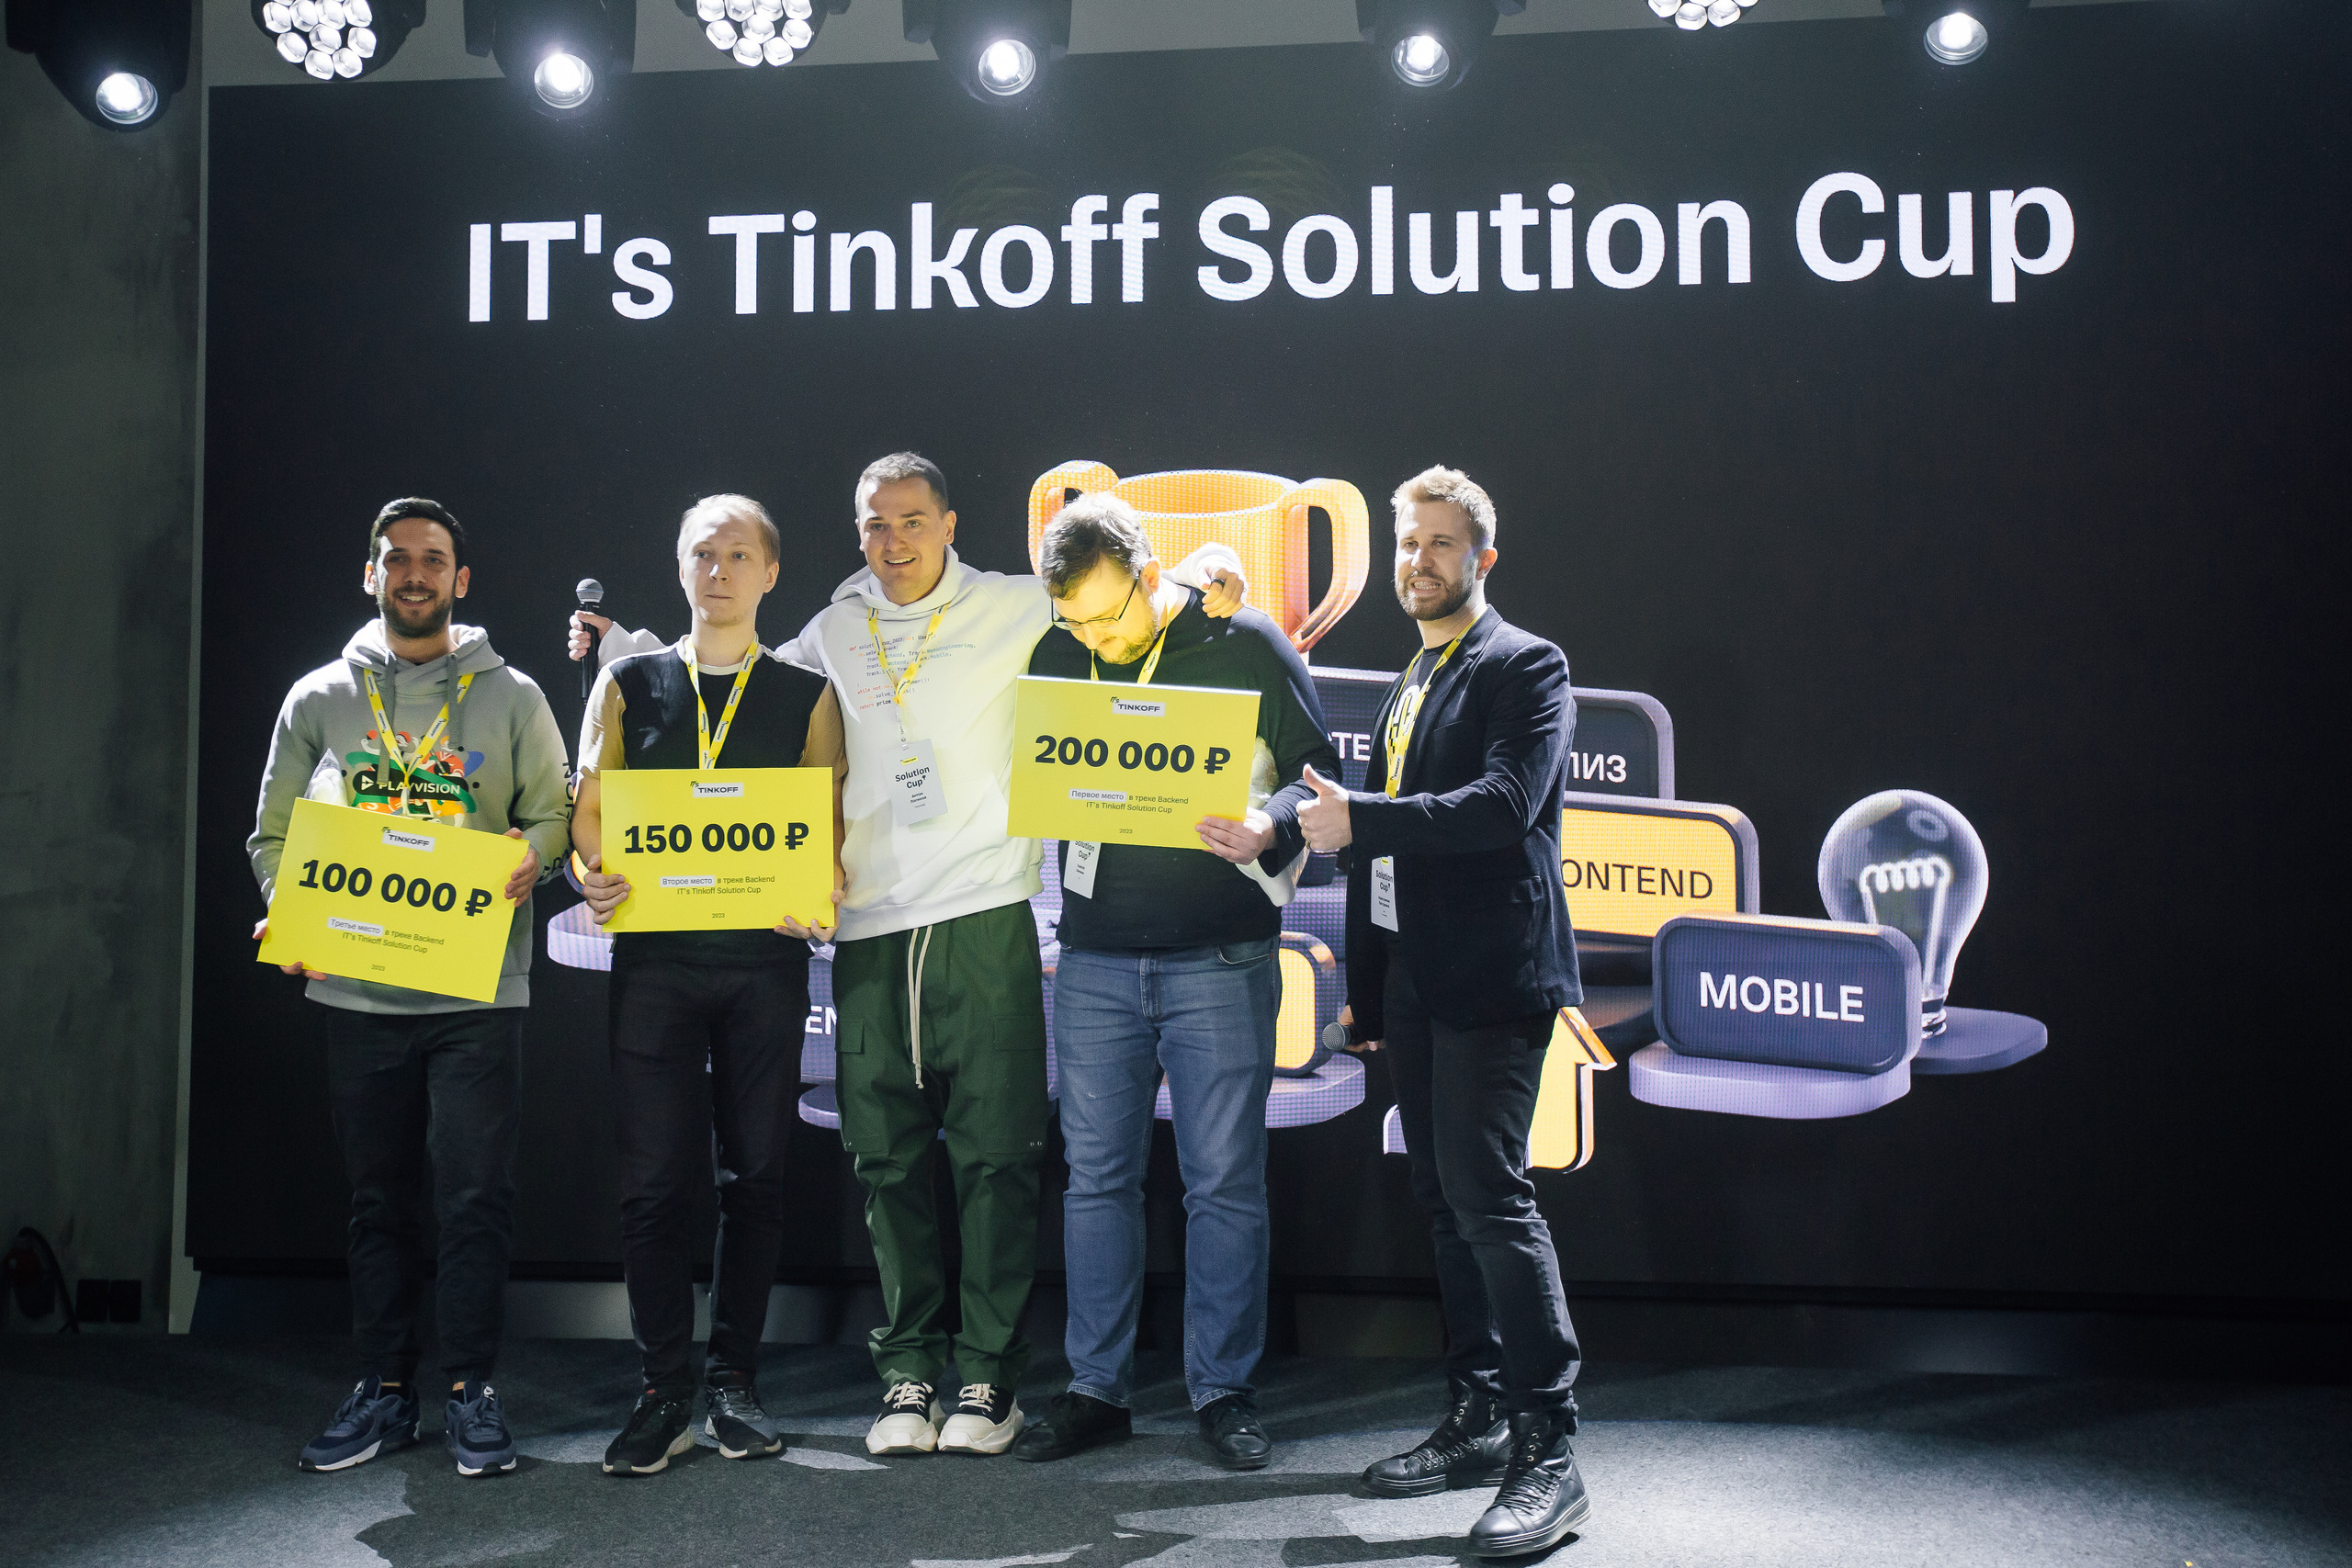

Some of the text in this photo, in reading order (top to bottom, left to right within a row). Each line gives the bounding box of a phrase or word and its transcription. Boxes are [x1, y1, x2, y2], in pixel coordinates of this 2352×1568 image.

[469, 171, 2075, 322] IT's Tinkoff Solution Cup
[1118, 704, 1160, 712] TINKOFF
[1035, 735, 1109, 768] 200
[1118, 740, 1195, 773] 000
[895, 766, 930, 783] Solution
[697, 786, 739, 795] TINKOFF
[906, 779, 923, 789] Cup
[1071, 790, 1100, 800] Первое
[1135, 795, 1157, 804] треке
[1158, 795, 1189, 805] Backend
[1102, 802, 1125, 811] Tinkoff
[1126, 804, 1158, 813] Solution
[1158, 805, 1172, 814] Cup
[388, 834, 429, 847] TINKOFF
[625, 824, 693, 854] 150
[701, 822, 775, 852] 000
[299, 859, 373, 897] 100
[381, 873, 457, 912] 000
[662, 878, 688, 887] Второе
[745, 875, 775, 884] Backend
[692, 886, 716, 896] Tinkoff
[717, 886, 746, 895] Solution
[747, 886, 762, 895] Cup
[331, 919, 356, 932] Третье
[357, 924, 381, 934] место
[390, 931, 413, 941] треке
[413, 932, 445, 945] Backend
[357, 934, 381, 945] Tinkoff
[382, 939, 412, 952] Solution
[413, 943, 428, 953] Cup
[1700, 971, 1864, 1023] MOBILE
